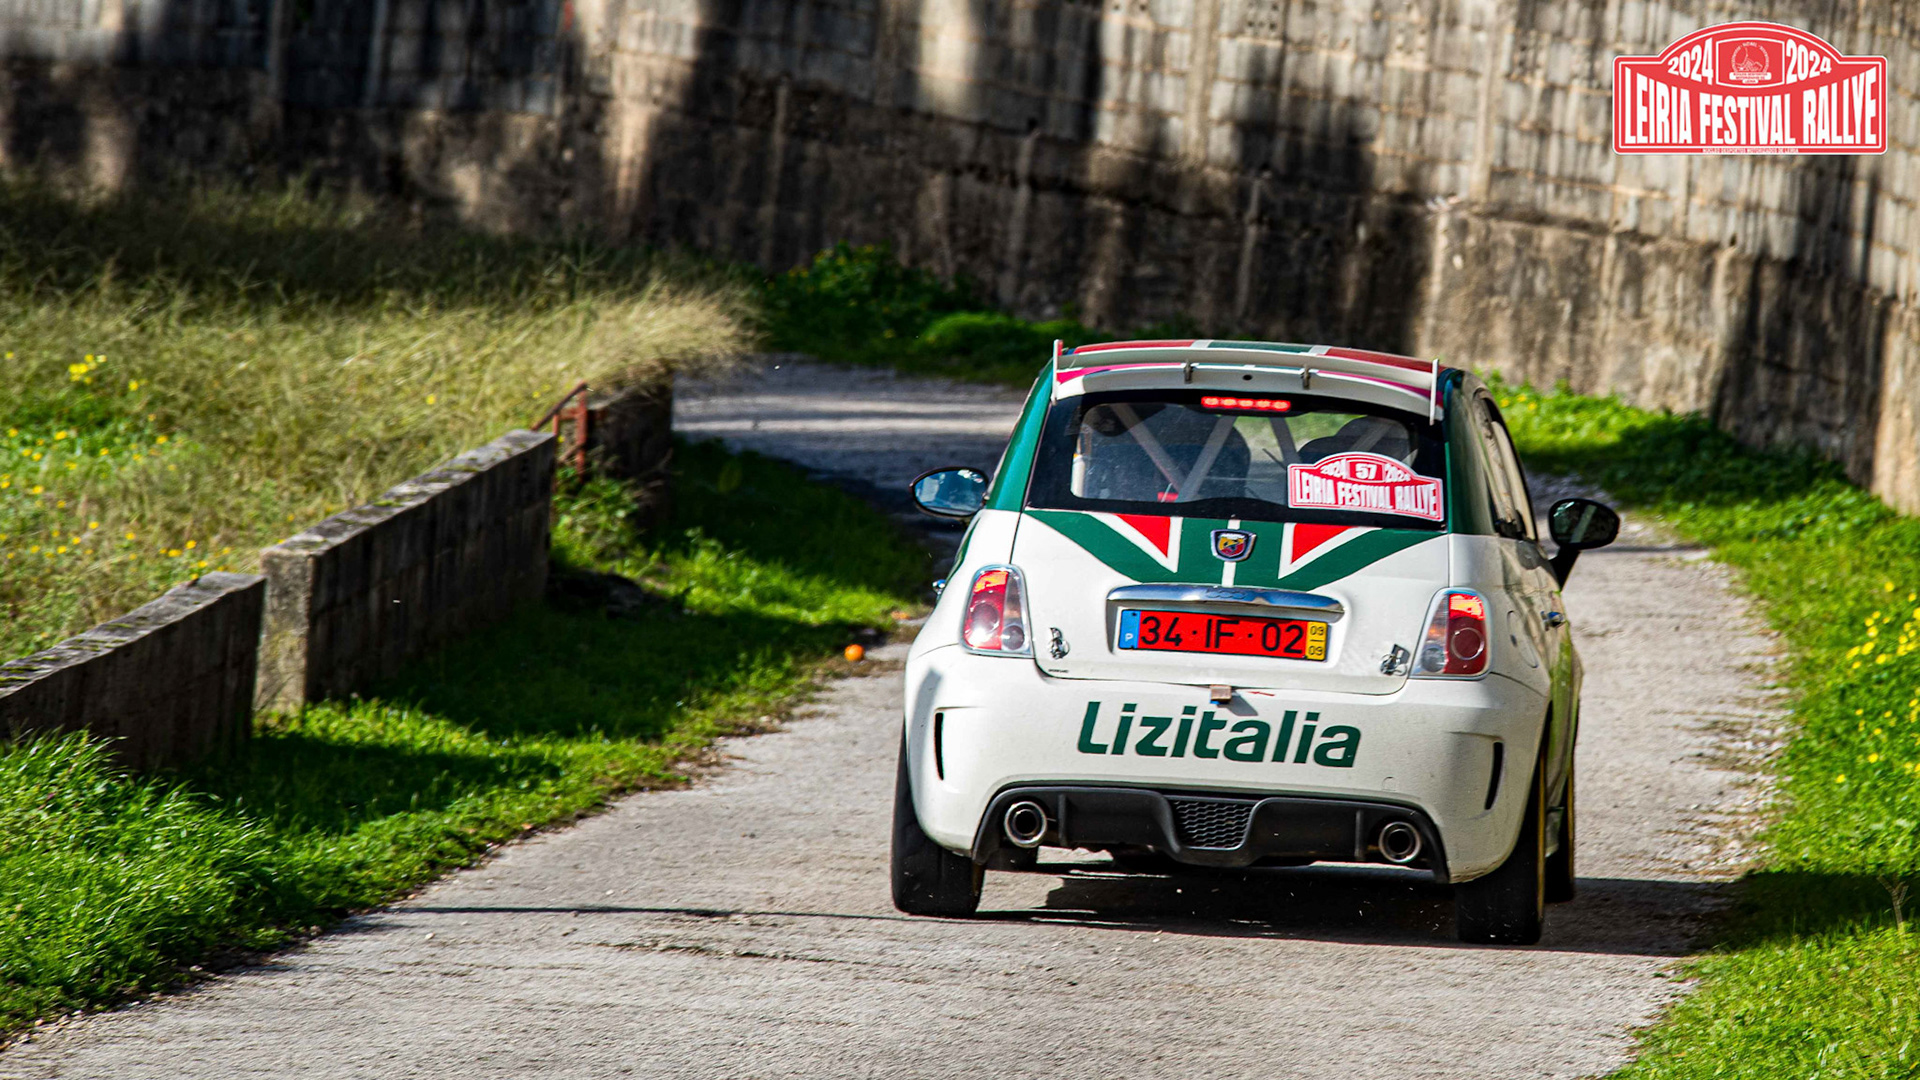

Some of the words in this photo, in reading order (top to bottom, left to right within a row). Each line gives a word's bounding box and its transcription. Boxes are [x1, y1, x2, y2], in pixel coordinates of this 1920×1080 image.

[1320, 458, 1347, 480] 2024
[1355, 463, 1377, 480] 57
[1384, 463, 1411, 483] 2024
[1294, 469, 1336, 505] LEIRIA
[1336, 481, 1394, 508] FESTIVAL
[1395, 482, 1437, 516] RALLYE
[1125, 632, 1134, 643] P
[1076, 700, 1362, 769] Lizitalia
